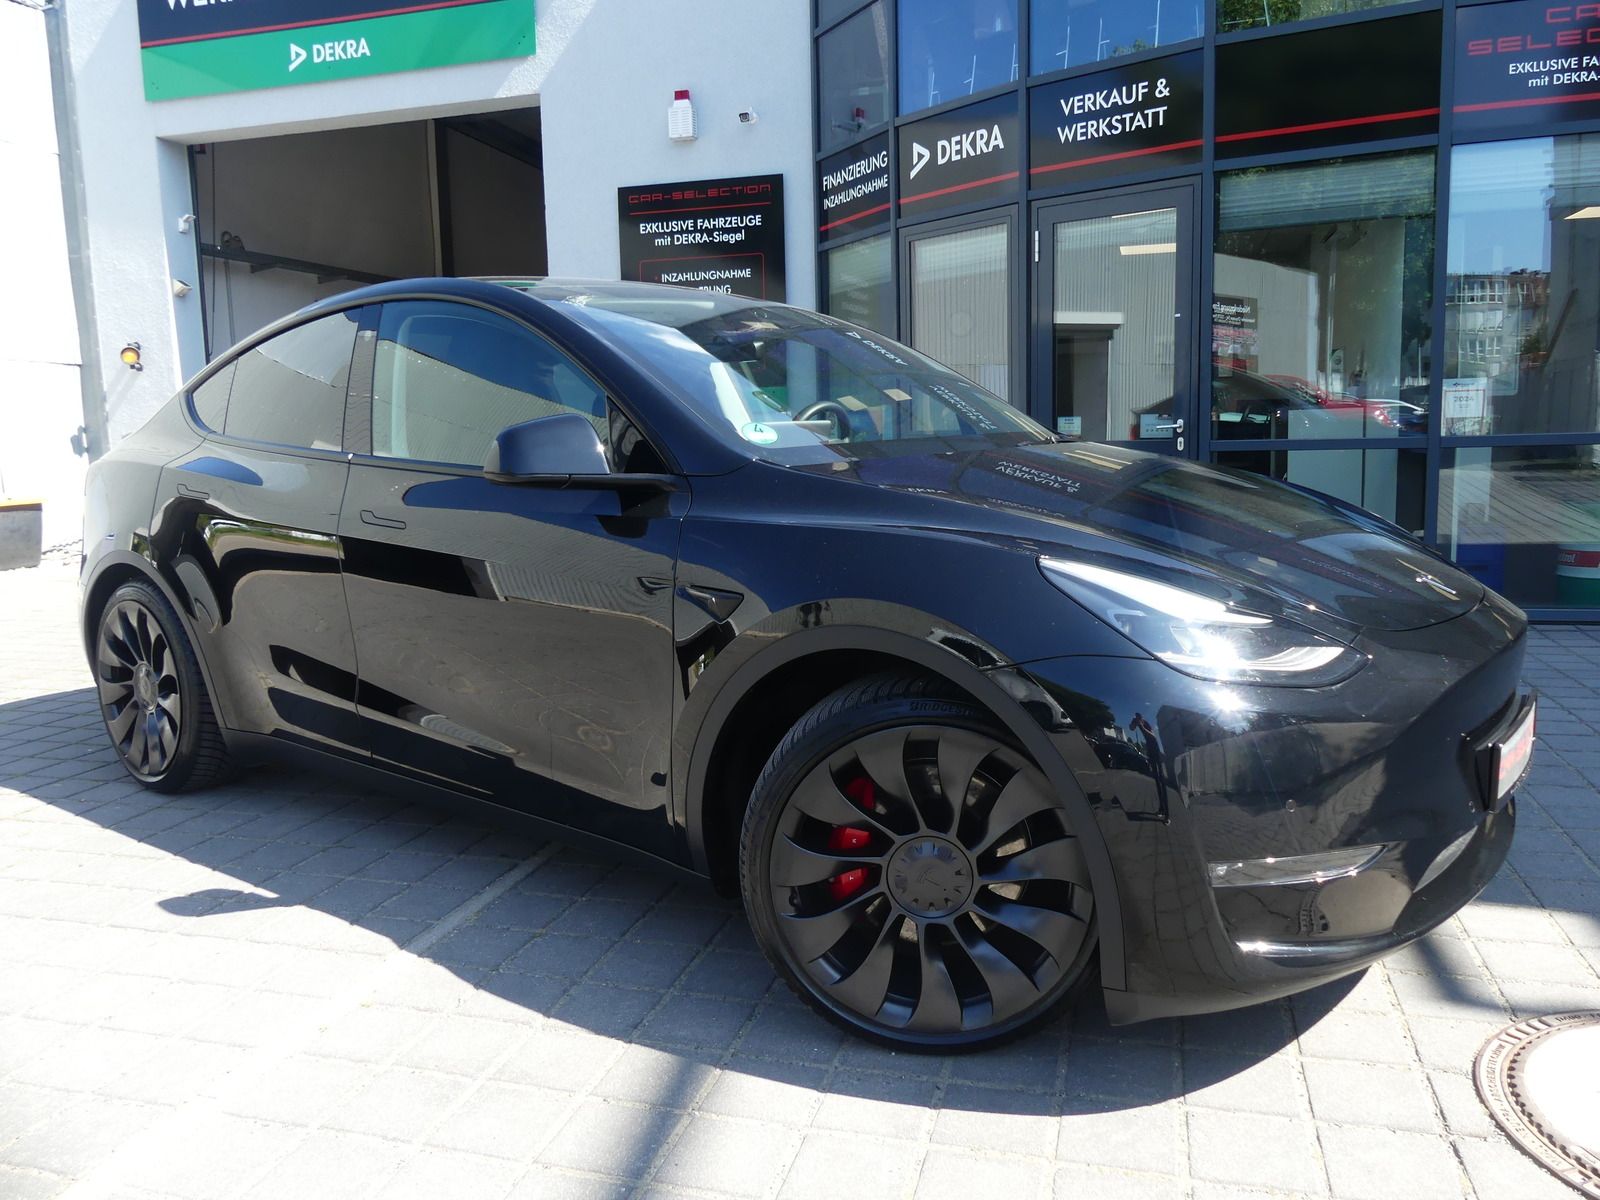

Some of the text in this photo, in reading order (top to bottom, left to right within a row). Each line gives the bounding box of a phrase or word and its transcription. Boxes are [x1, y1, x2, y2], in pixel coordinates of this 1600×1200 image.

[1546, 3, 1600, 23] CA
[312, 37, 371, 63] DEKRA
[1467, 27, 1600, 55] SELEC
[1508, 56, 1600, 75] EXKLUSIVE FA
[1528, 71, 1600, 87] mit DEKRA-
[1060, 78, 1170, 117] VERKAUF &
[1056, 105, 1168, 144] WERKSTATT
[937, 124, 1004, 165] DEKRA
[823, 150, 888, 191] FINANZIERUNG
[628, 184, 771, 204] CAR-SELECTION
[823, 174, 888, 210] INZAHLUNGNAHME
[639, 215, 762, 234] EXKLUSIVE FAHRZEUGE
[655, 229, 745, 247] mit DEKRA-Siegel
[661, 268, 752, 283] INZAHLUNGNAHME
